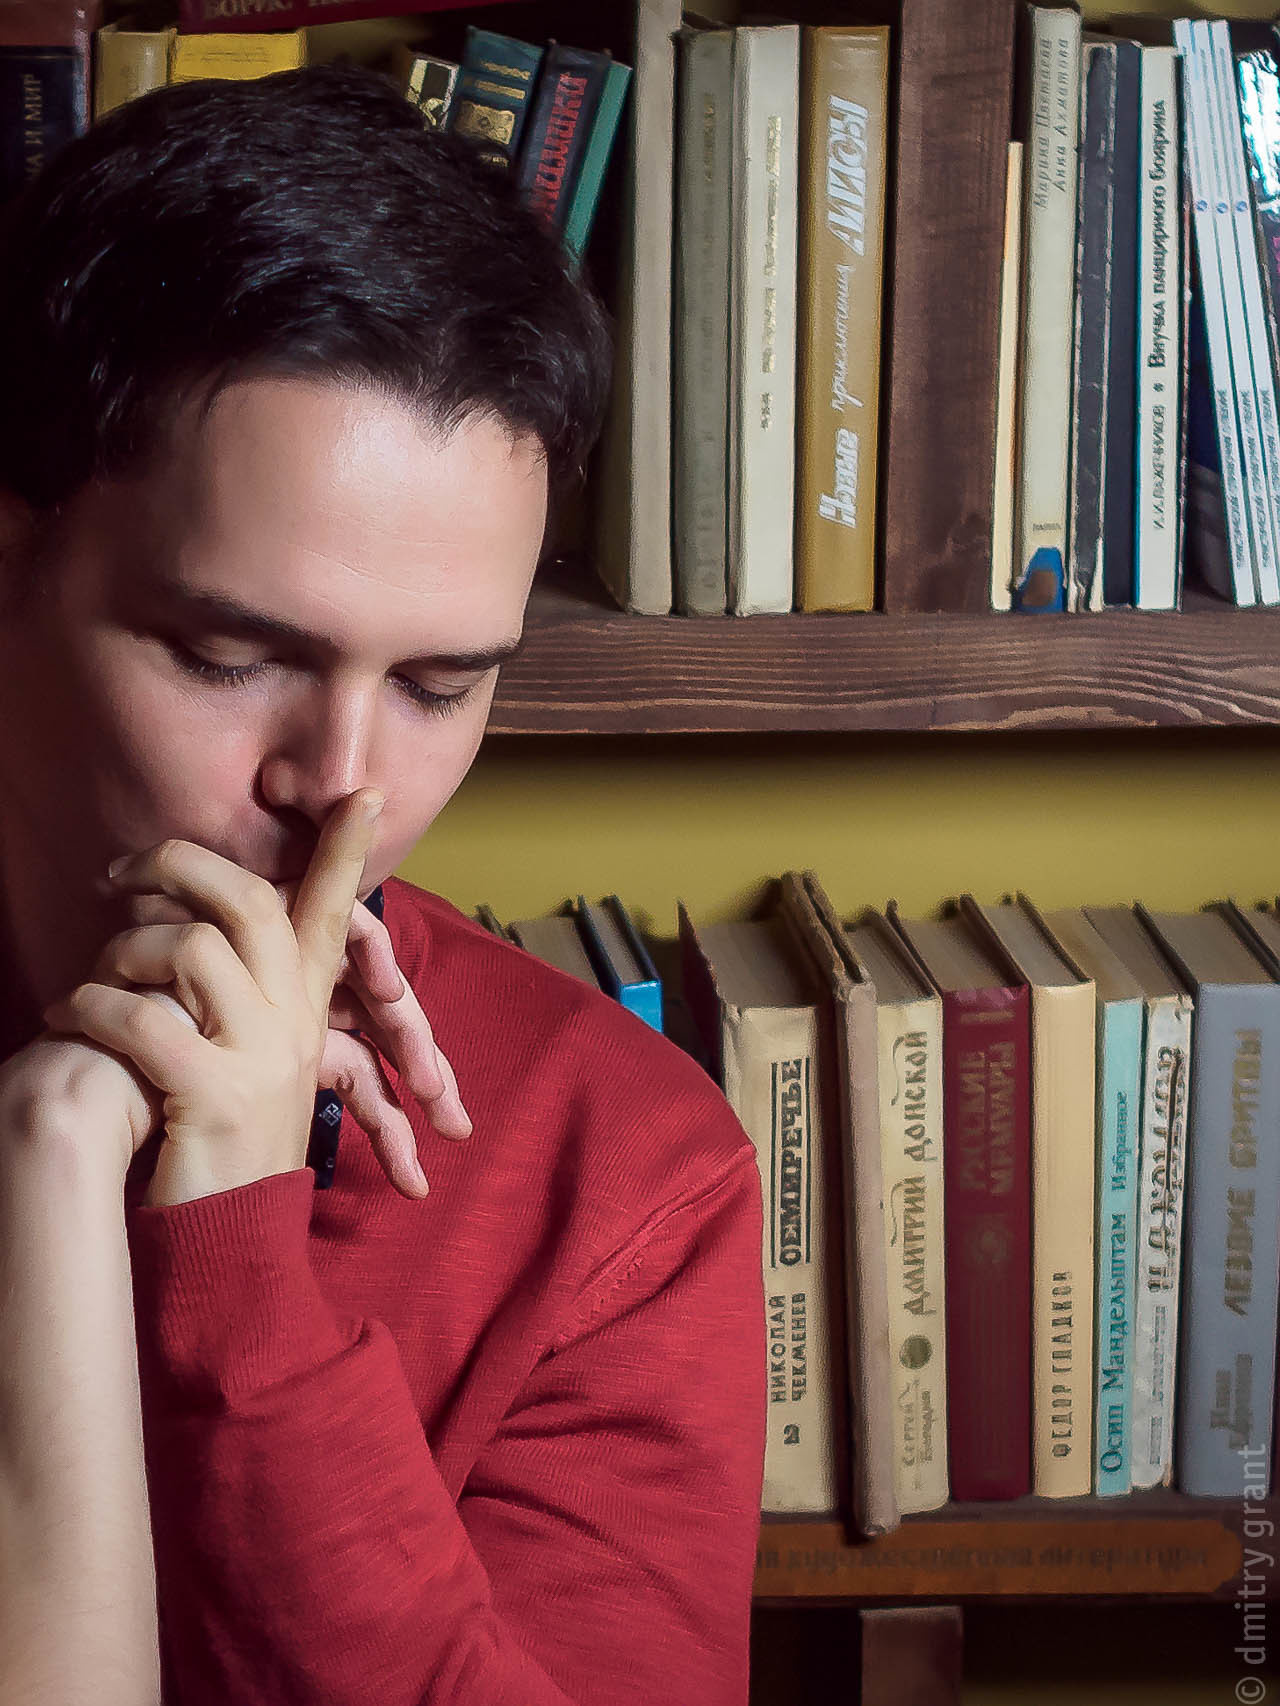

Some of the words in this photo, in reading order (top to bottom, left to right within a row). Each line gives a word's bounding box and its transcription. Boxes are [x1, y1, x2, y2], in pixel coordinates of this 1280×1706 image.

[769, 1294, 787, 1402] НИКОЛАЙ
[790, 1292, 807, 1401] ЧЕКМЕНЕВ
[1050, 1270, 1074, 1373] ГЛАДКОВ
[1102, 1213, 1132, 1391] Мандельштам
[1051, 1384, 1073, 1457] ФЕДОР
[1099, 1404, 1126, 1472] Осип
